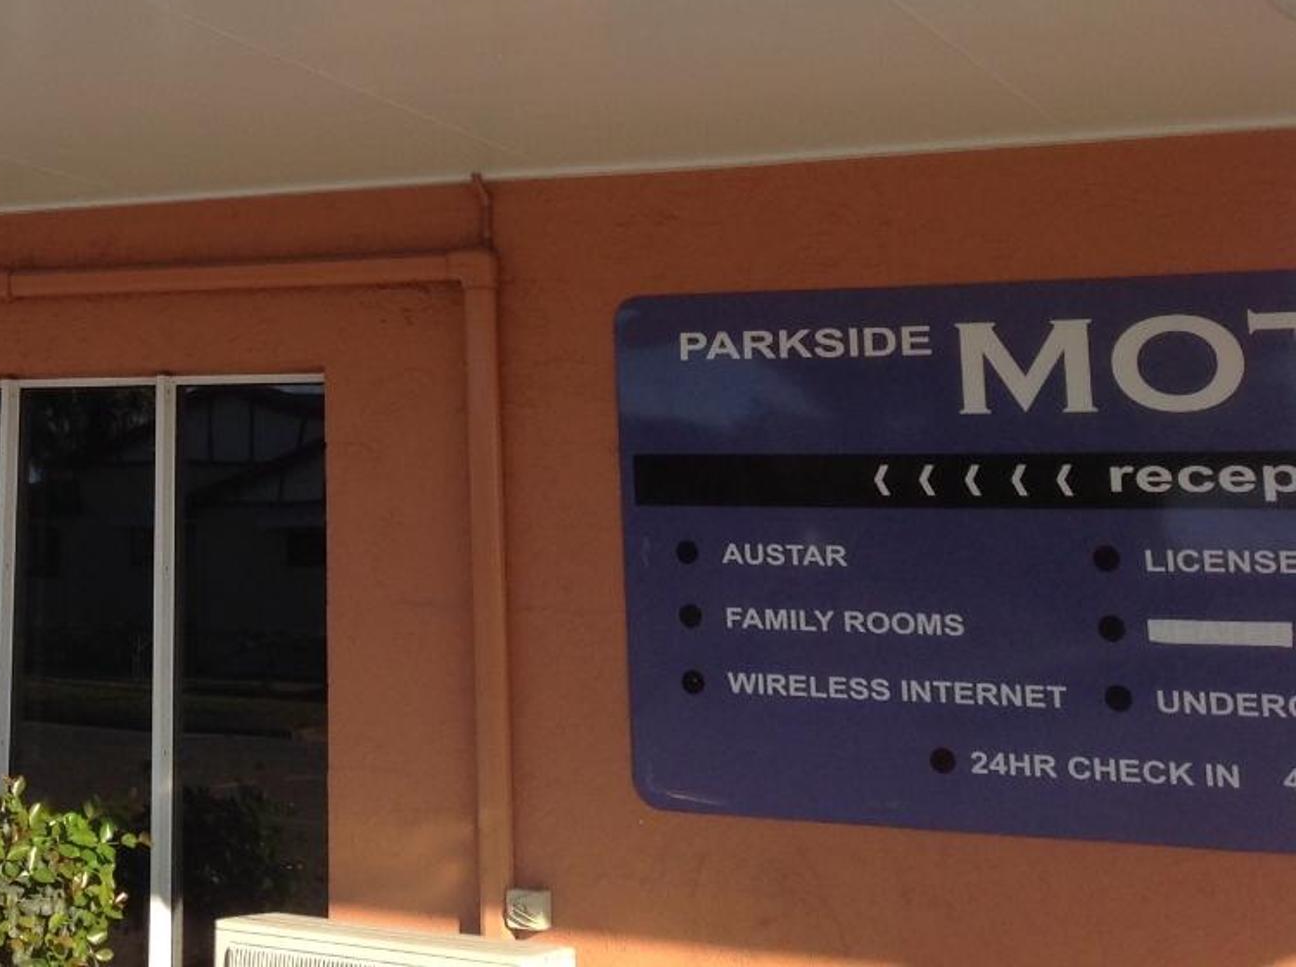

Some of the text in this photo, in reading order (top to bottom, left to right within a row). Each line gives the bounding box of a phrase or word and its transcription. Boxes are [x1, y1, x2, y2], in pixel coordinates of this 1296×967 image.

[679, 325, 933, 361] PARKSIDE
[722, 543, 848, 568] AUSTAR
[725, 607, 965, 637] FAMILY ROOMS
[727, 671, 1067, 709] WIRELESS INTERNET
[970, 750, 1240, 789] 24HR CHECK IN
